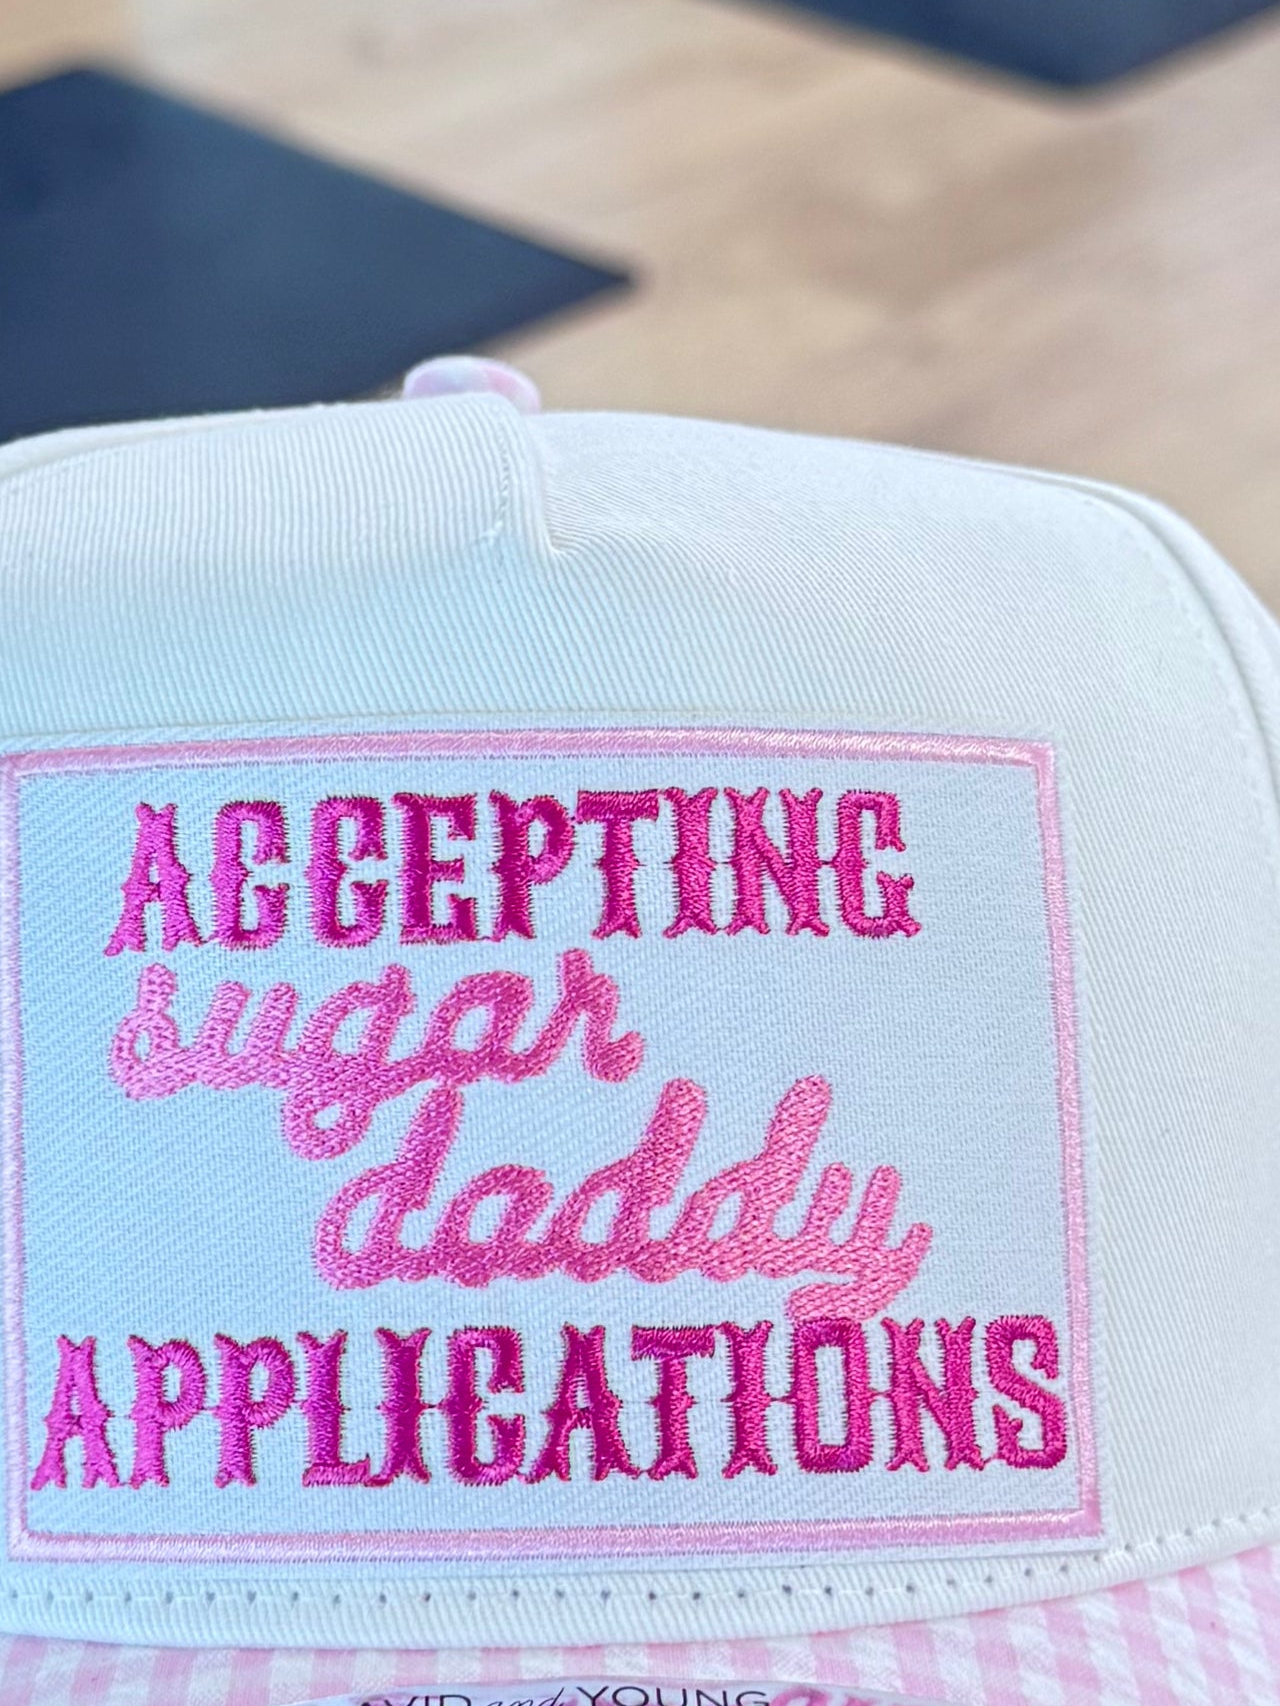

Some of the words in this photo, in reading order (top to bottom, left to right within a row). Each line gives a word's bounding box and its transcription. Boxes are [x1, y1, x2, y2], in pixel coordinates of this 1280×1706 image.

[104, 787, 922, 957] ACCEPTING
[109, 948, 645, 1160] sugar
[314, 1075, 933, 1321] daddy
[30, 1315, 1067, 1490] APPLICATIONS
